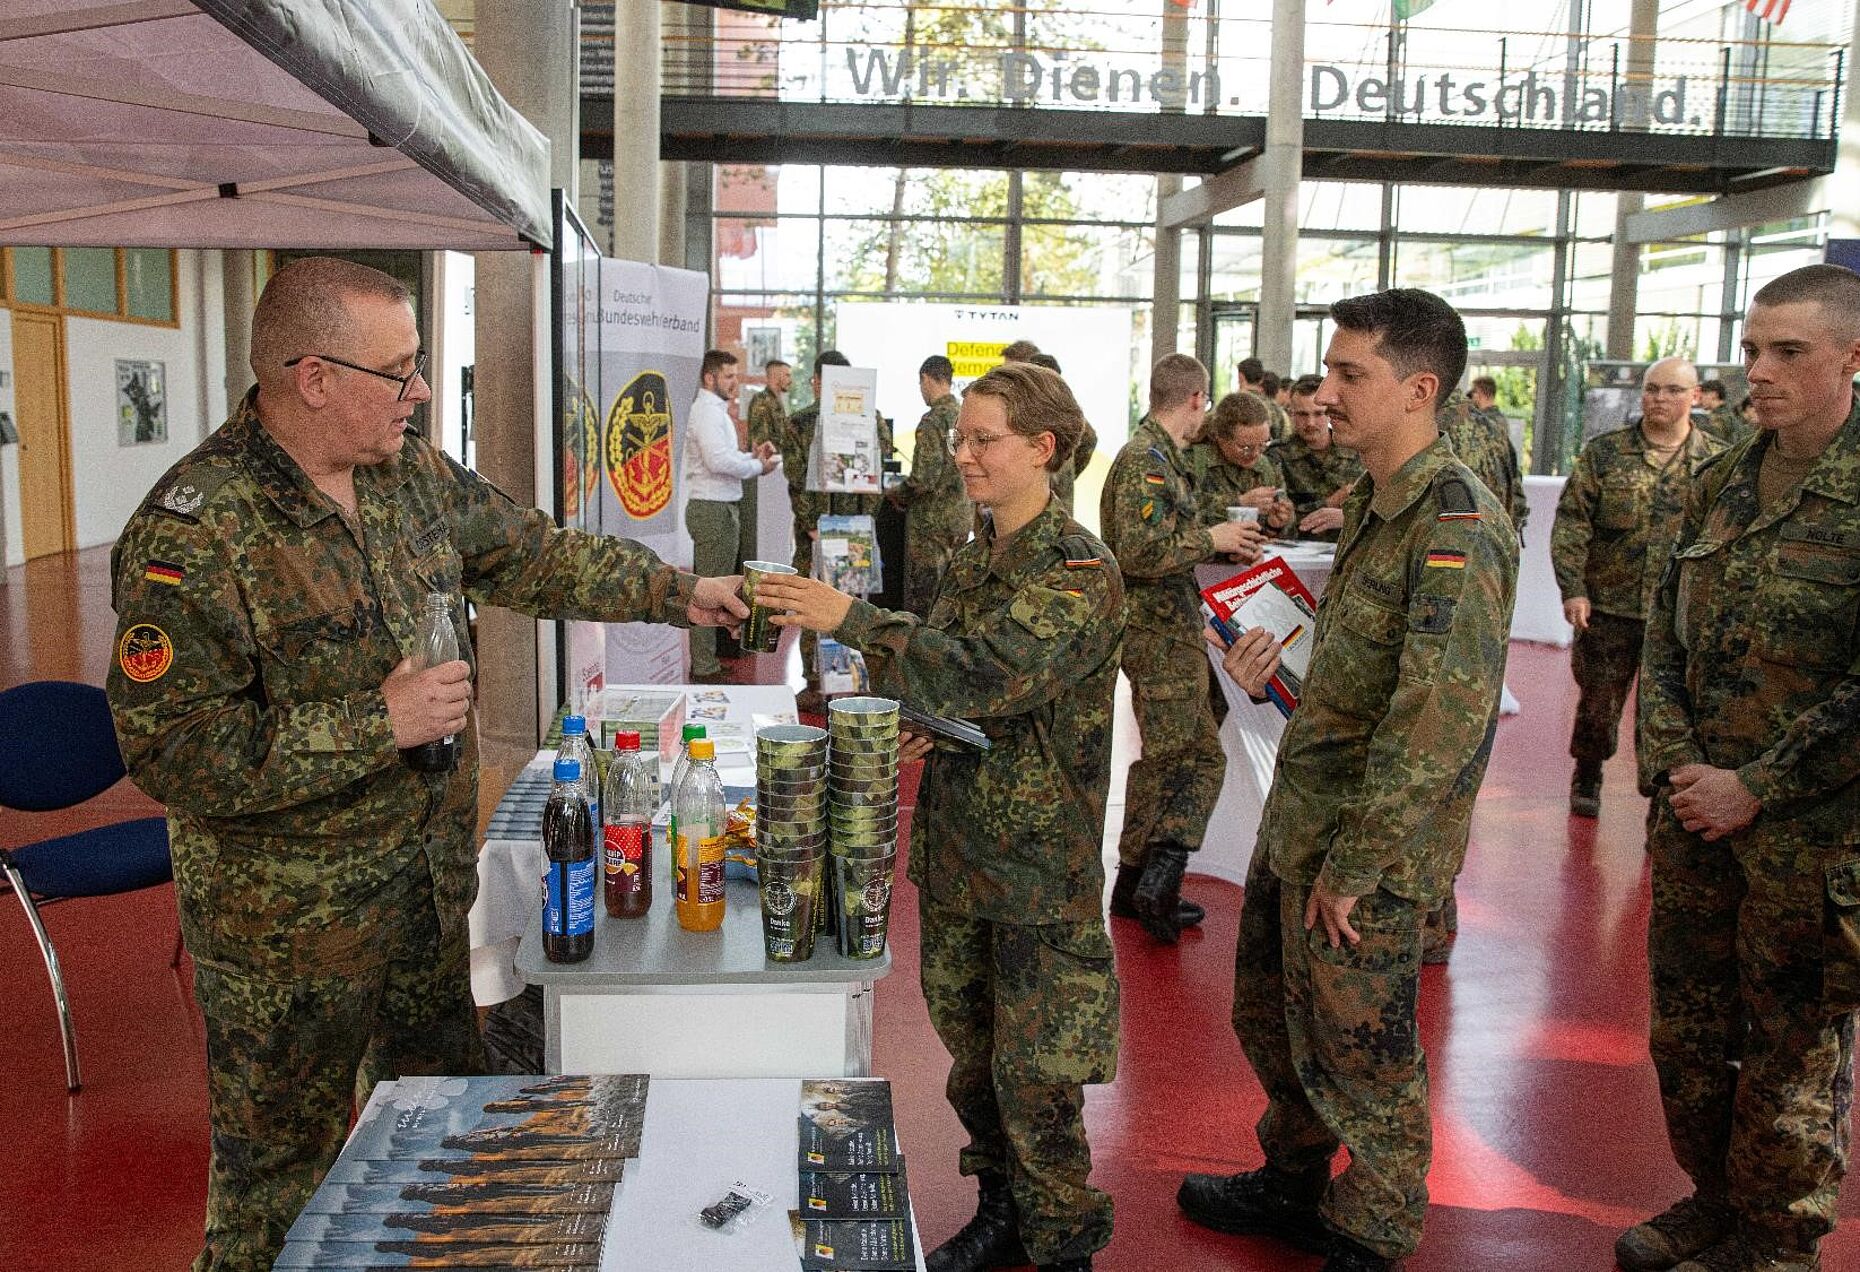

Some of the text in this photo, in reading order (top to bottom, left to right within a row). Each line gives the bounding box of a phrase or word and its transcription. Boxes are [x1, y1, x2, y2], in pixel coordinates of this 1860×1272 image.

[846, 46, 1701, 126] Wir. Dienen. Deutschland.
[968, 311, 1019, 321] TYTAN
[1806, 527, 1845, 544] NOLTE
[770, 917, 791, 927] Danke
